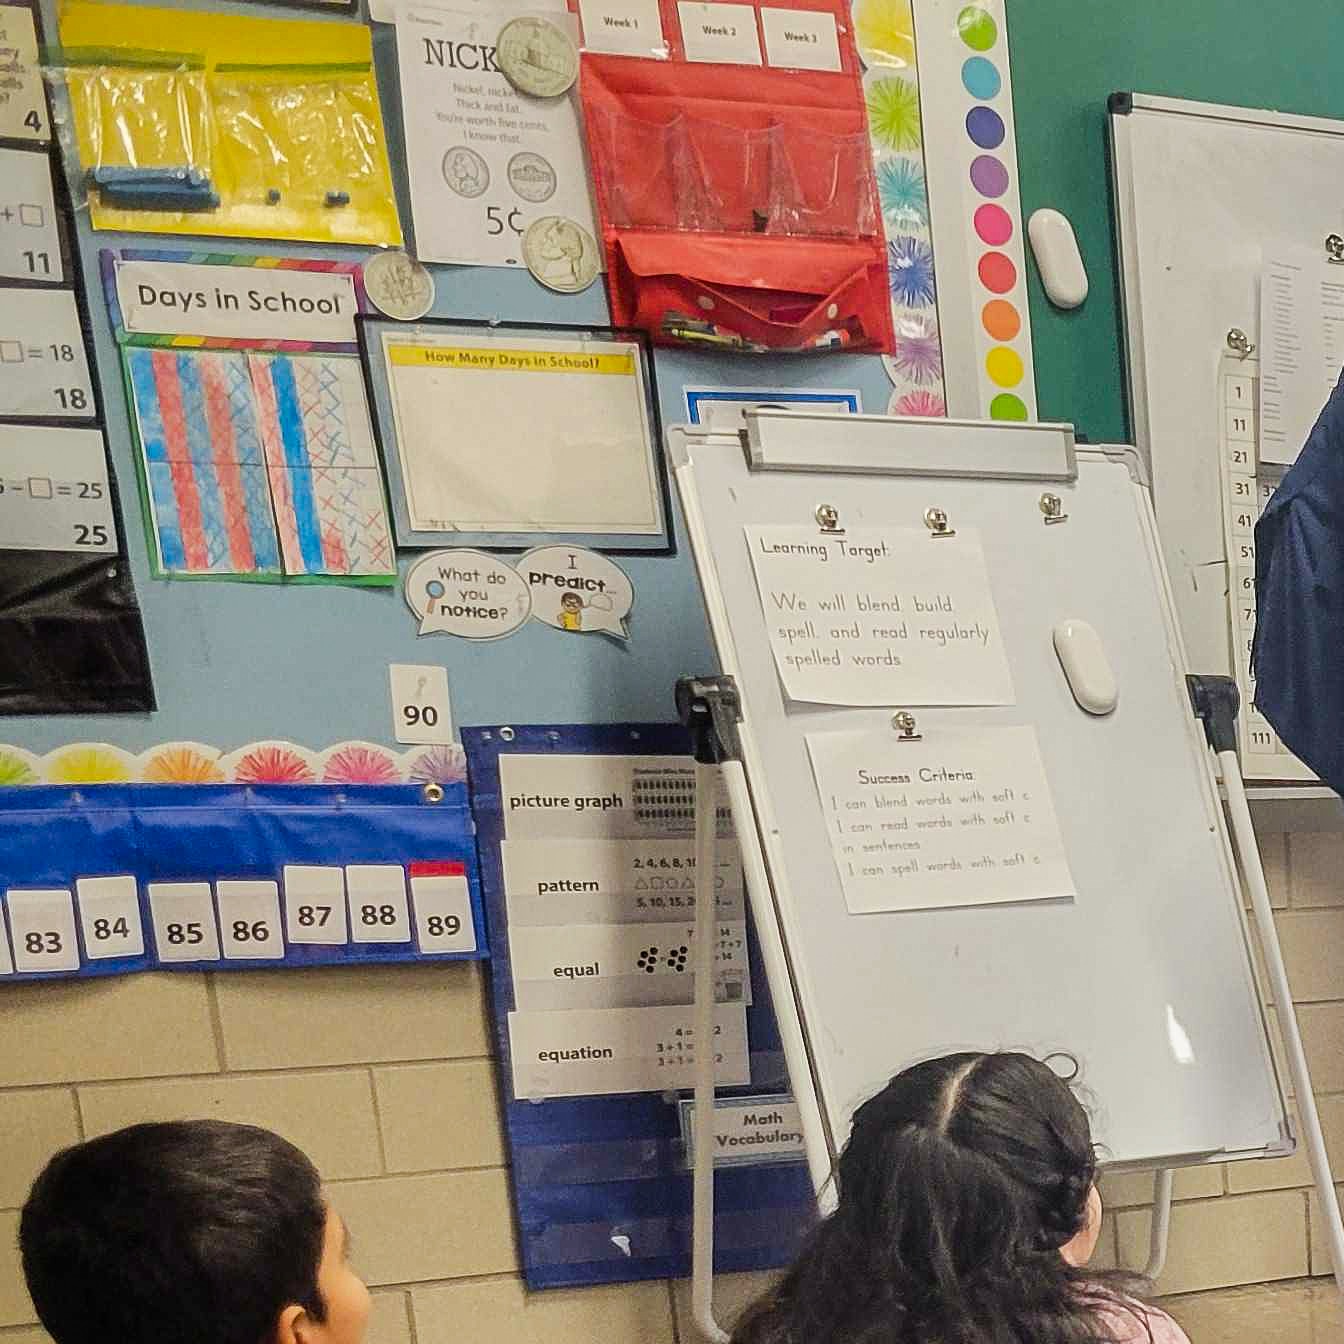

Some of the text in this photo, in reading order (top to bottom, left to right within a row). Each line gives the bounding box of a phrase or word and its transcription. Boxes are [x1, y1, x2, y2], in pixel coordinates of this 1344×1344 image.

[603, 17, 638, 30] Week 1
[702, 25, 737, 37] Week 2
[783, 31, 817, 44] Week 3
[422, 37, 502, 73] NICK
[24, 110, 42, 133] 4
[487, 206, 525, 237] 5¢
[23, 250, 50, 274] 11
[138, 284, 341, 314] Days in School
[49, 344, 75, 362] 18
[424, 350, 456, 363] How
[459, 352, 495, 369] Many
[499, 354, 530, 370] Days
[533, 355, 547, 367] in
[53, 387, 88, 410] 18
[1235, 386, 1242, 399] 1
[1233, 418, 1247, 431] 11
[1233, 450, 1248, 463] 21
[76, 482, 103, 500] 25
[1235, 482, 1250, 496] 31
[1238, 514, 1252, 528] 41
[73, 524, 108, 546] 25
[759, 537, 828, 561] Learning
[567, 554, 578, 569] I
[438, 566, 507, 585] What do
[458, 589, 489, 602] you
[771, 592, 807, 611] We
[818, 592, 846, 612] will
[440, 603, 508, 620] notice?
[830, 622, 860, 639] and
[872, 622, 908, 640] read
[919, 622, 990, 646] regularly
[785, 649, 841, 672] spelled
[403, 705, 439, 727] 90
[857, 769, 911, 785] Success
[510, 792, 624, 812] picture graph
[846, 800, 867, 810] can
[874, 795, 908, 809] blend
[916, 792, 953, 806] words
[851, 823, 873, 833] can
[880, 818, 908, 832] read
[916, 815, 953, 829] words
[537, 878, 600, 895] pattern
[24, 904, 462, 954] 83 84 85 86 87 88 89
[553, 962, 600, 980] equal
[538, 1045, 613, 1062] equation
[743, 1111, 783, 1127] Math
